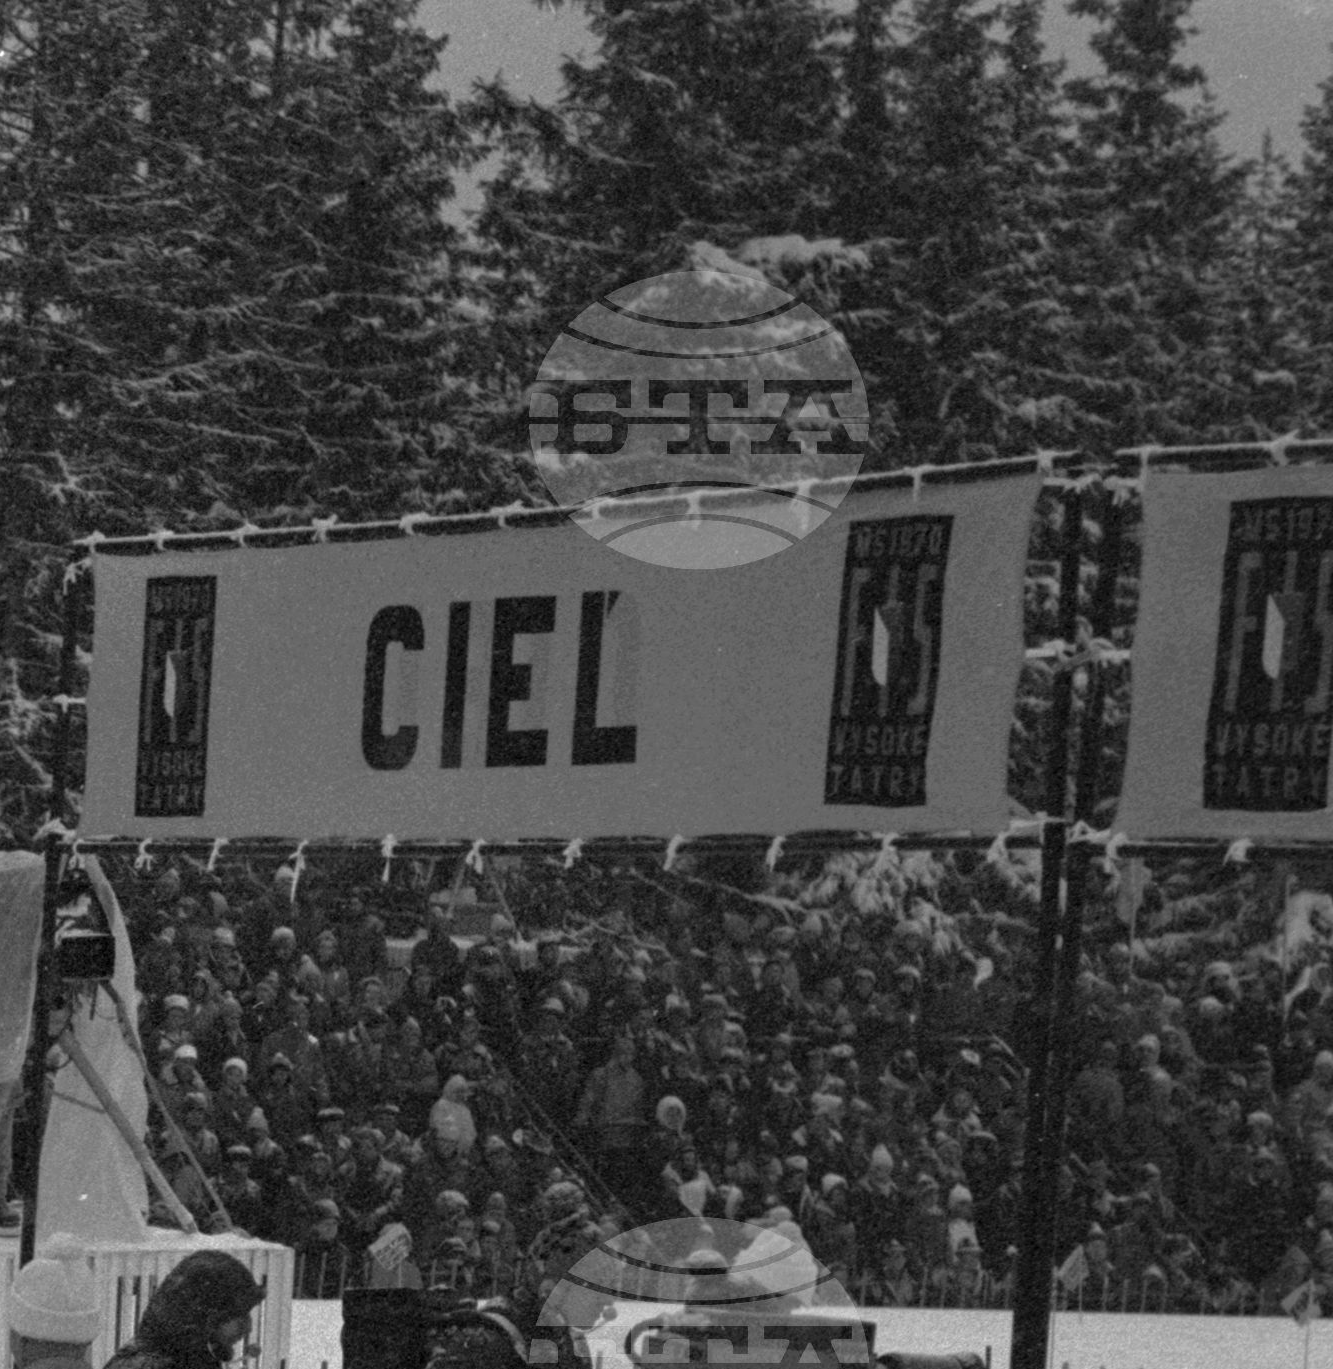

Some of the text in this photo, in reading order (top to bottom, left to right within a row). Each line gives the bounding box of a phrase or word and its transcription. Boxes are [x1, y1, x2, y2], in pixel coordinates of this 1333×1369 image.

[361, 591, 637, 771] CIEL
[829, 764, 922, 797] TATRY
[1211, 763, 1324, 799] TATRY
